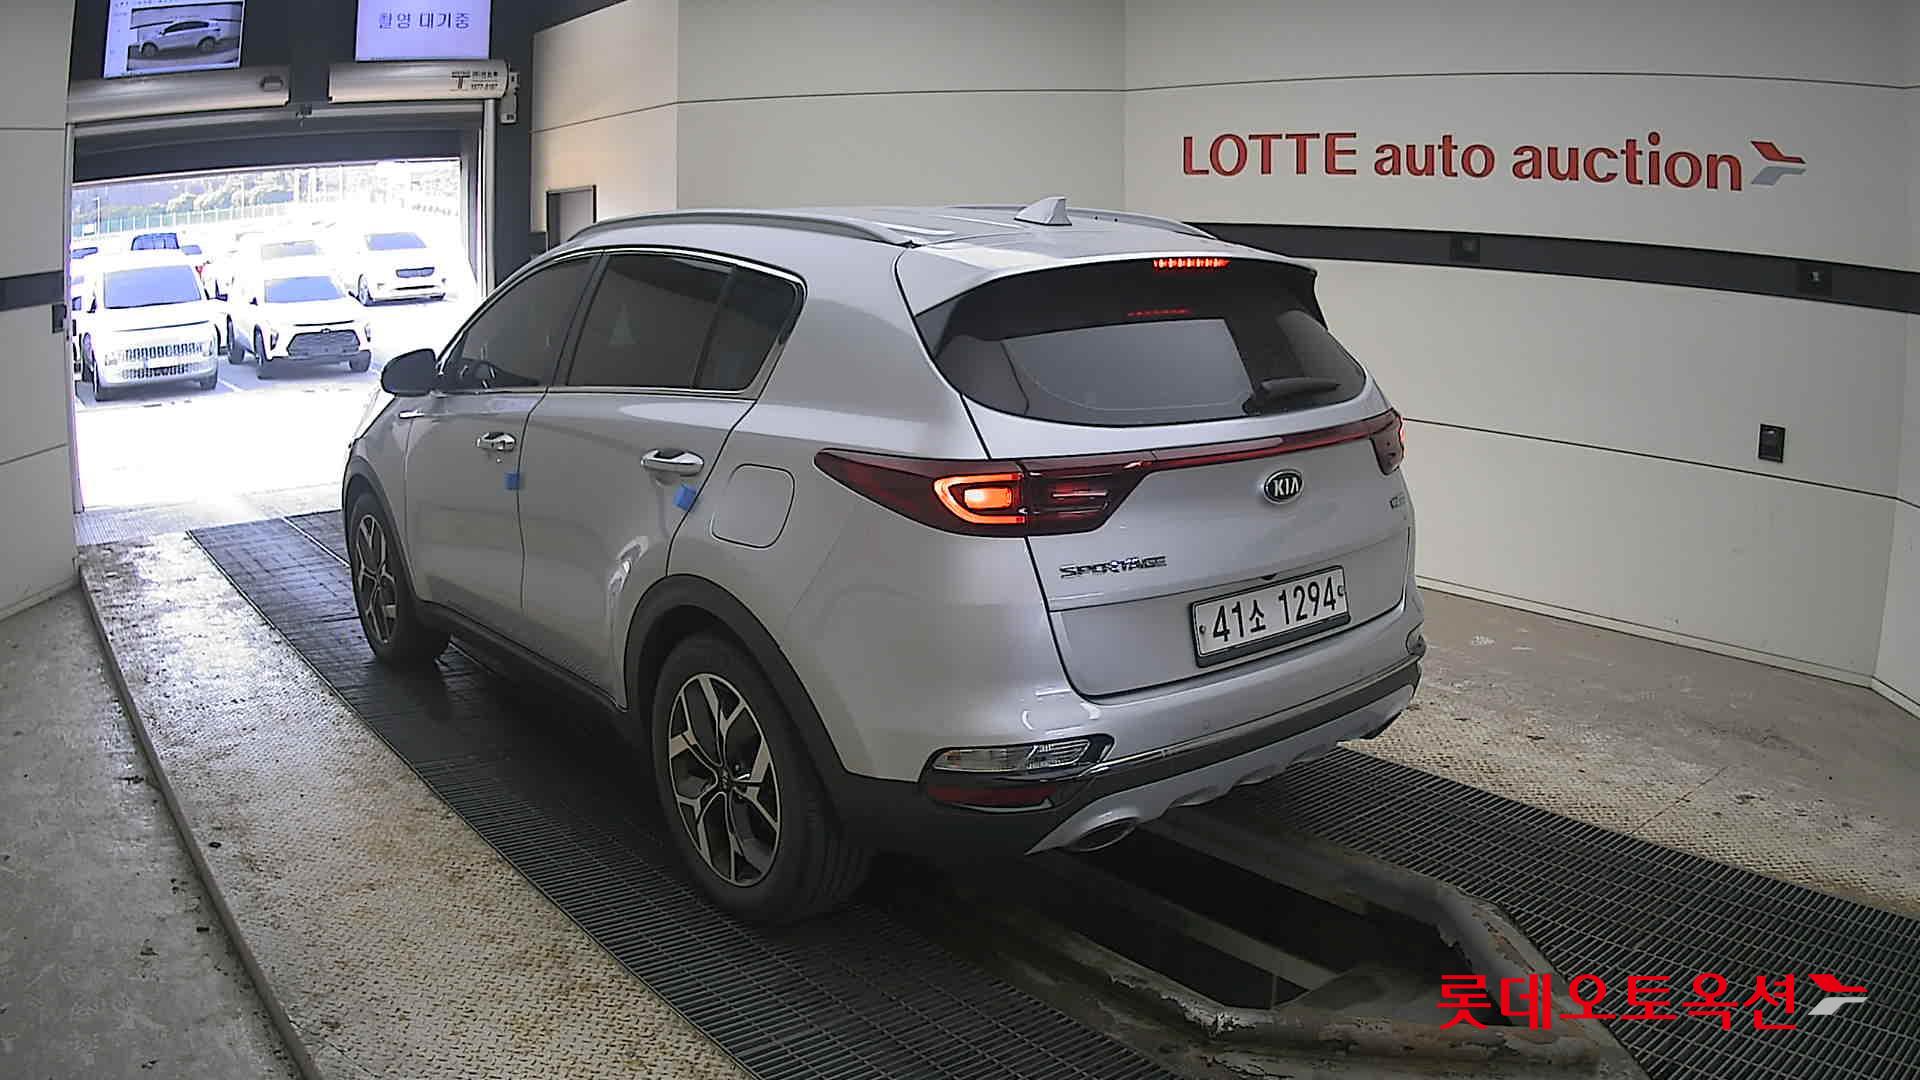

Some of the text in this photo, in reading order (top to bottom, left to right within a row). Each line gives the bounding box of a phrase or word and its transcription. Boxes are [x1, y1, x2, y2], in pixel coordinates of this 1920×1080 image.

[419, 11, 471, 30] 대기중
[1182, 131, 1743, 191] LOTTE auto auction
[1273, 476, 1301, 498] KIA
[1058, 555, 1167, 579] SPORTAGE
[1211, 575, 1337, 642] 41소 1294
